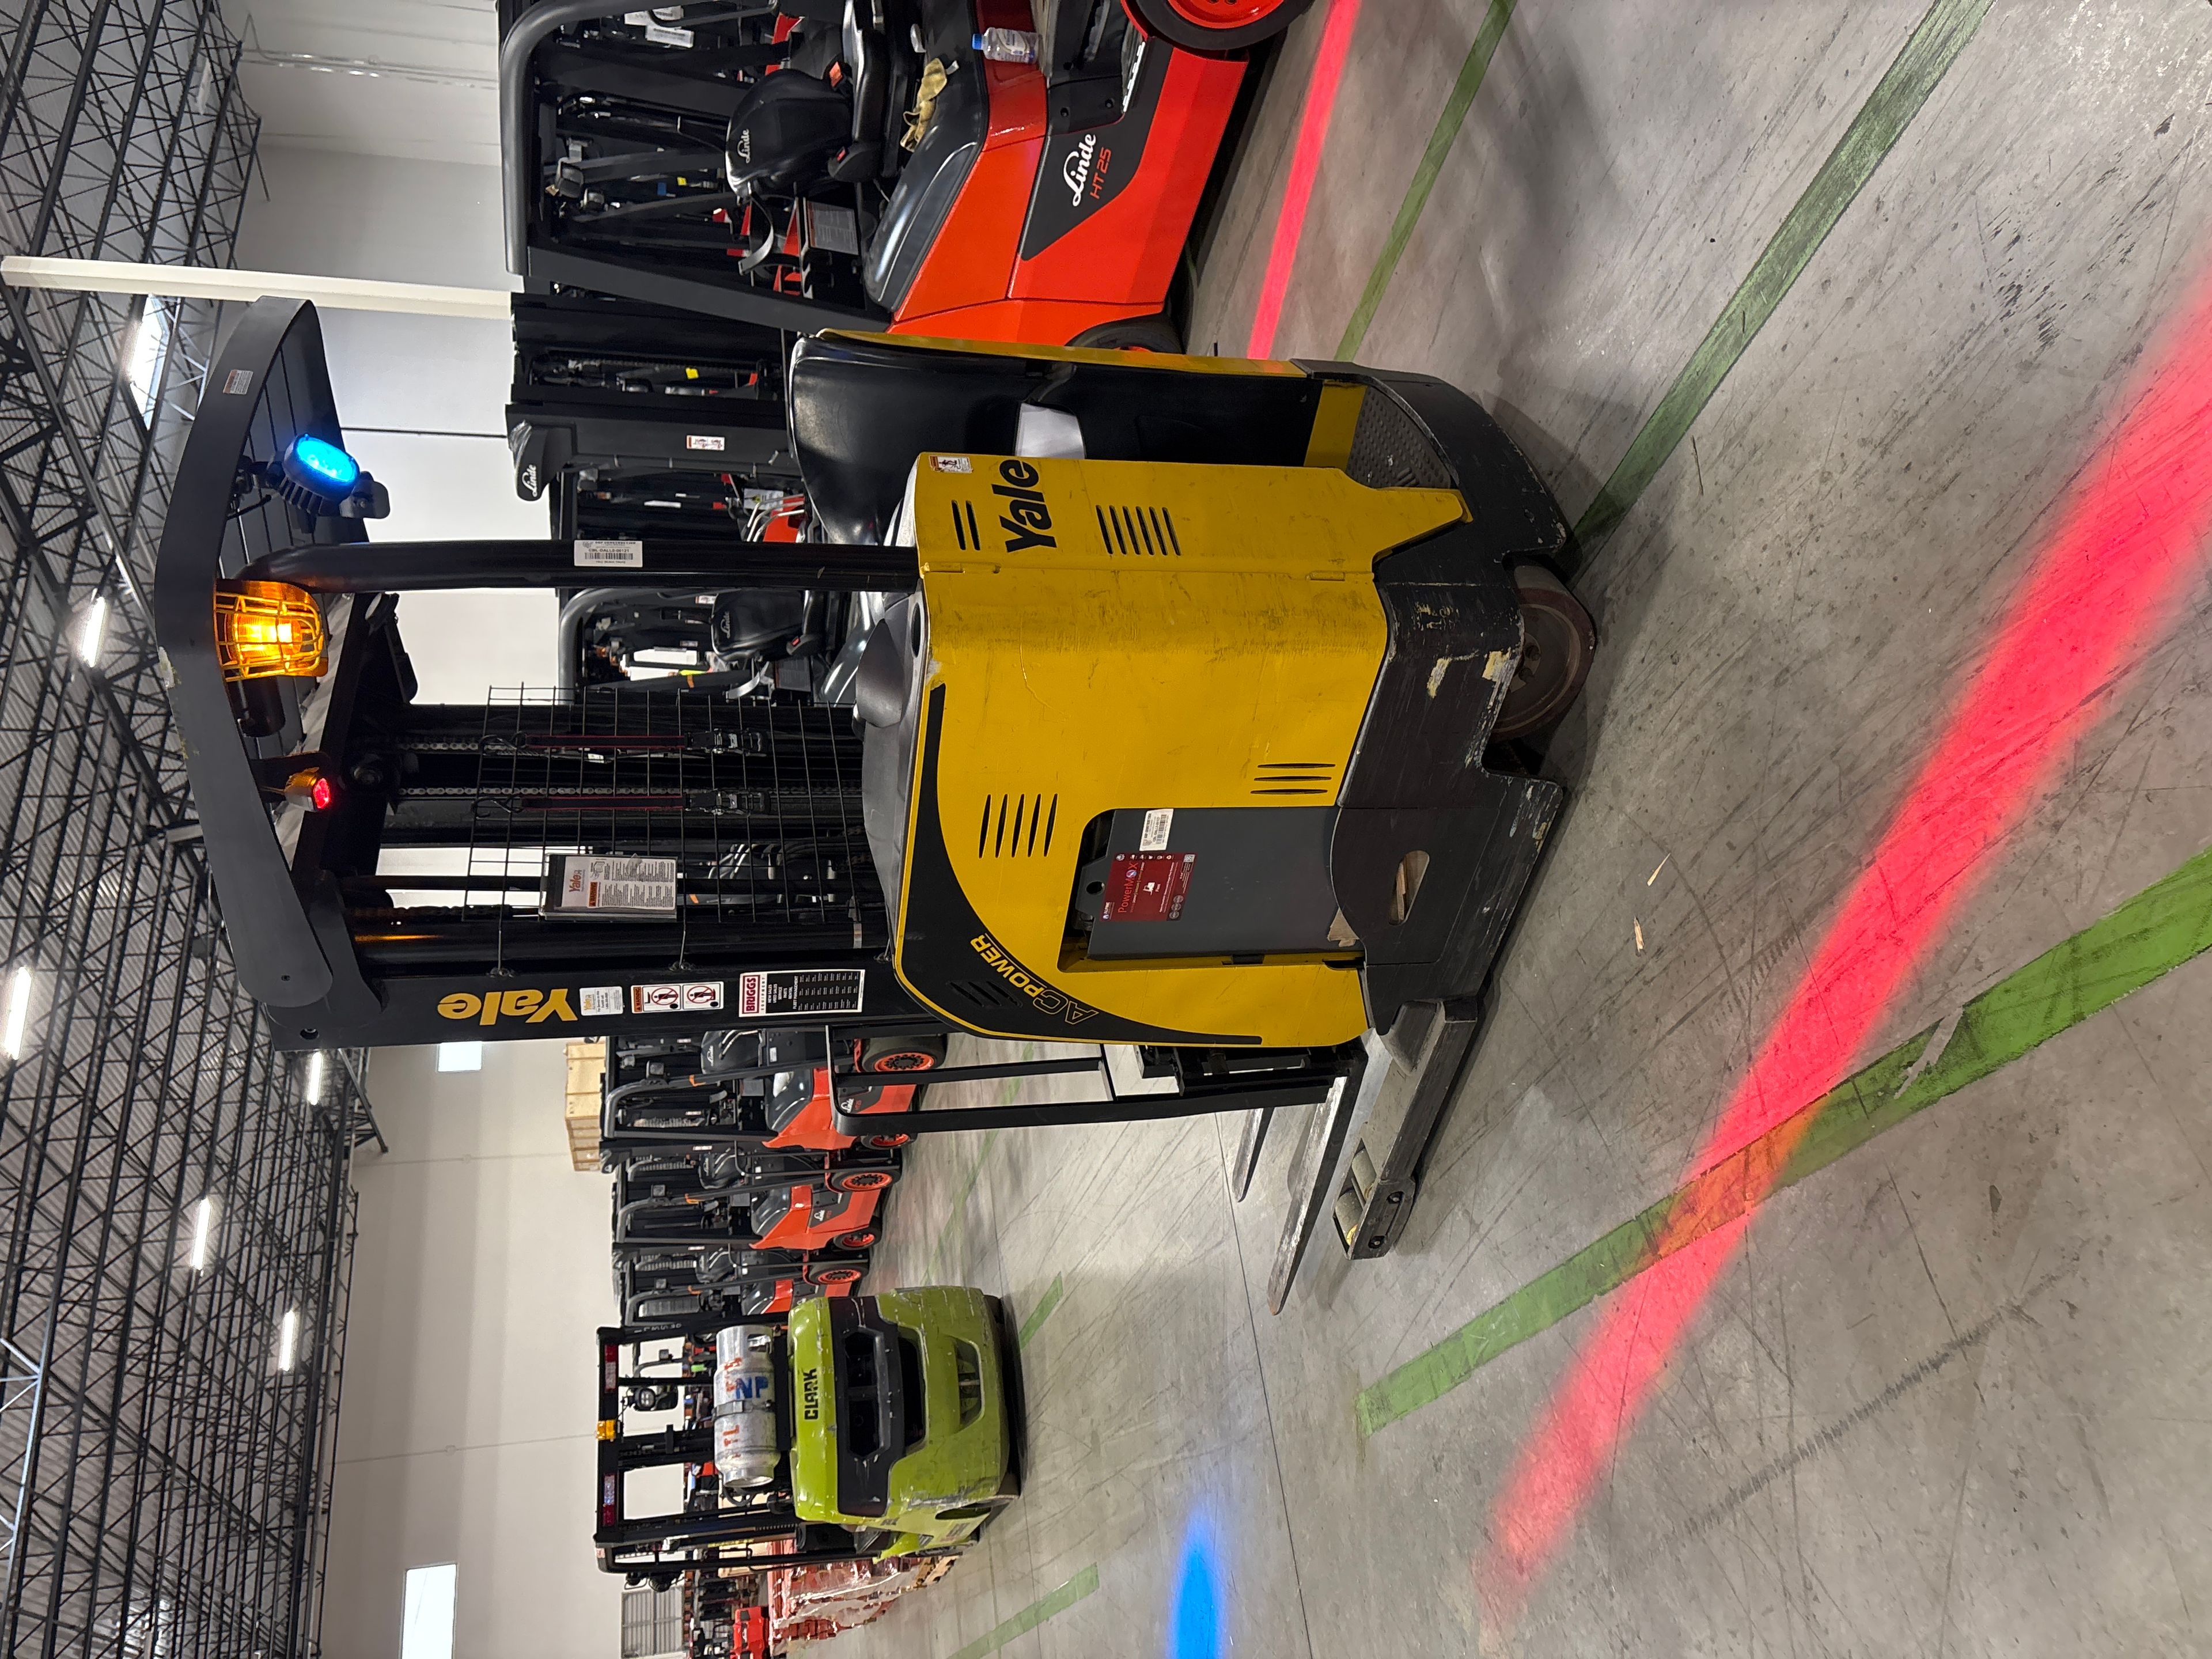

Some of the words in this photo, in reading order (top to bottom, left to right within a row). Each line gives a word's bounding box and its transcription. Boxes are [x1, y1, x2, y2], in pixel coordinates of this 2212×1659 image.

[737, 129, 750, 164] Linde
[1063, 134, 1096, 206] Linde
[522, 464, 537, 497] Linde
[991, 460, 1057, 553] Yale
[720, 612, 730, 639] Linde
[569, 874, 581, 893] Yale
[970, 934, 1045, 997] POWER
[437, 988, 578, 1025] Yale
[746, 978, 756, 1012] BRIGGS
[1032, 990, 1099, 1024] AC
[841, 1099, 854, 1113] Linde
[803, 1368, 818, 1419] CLARK
